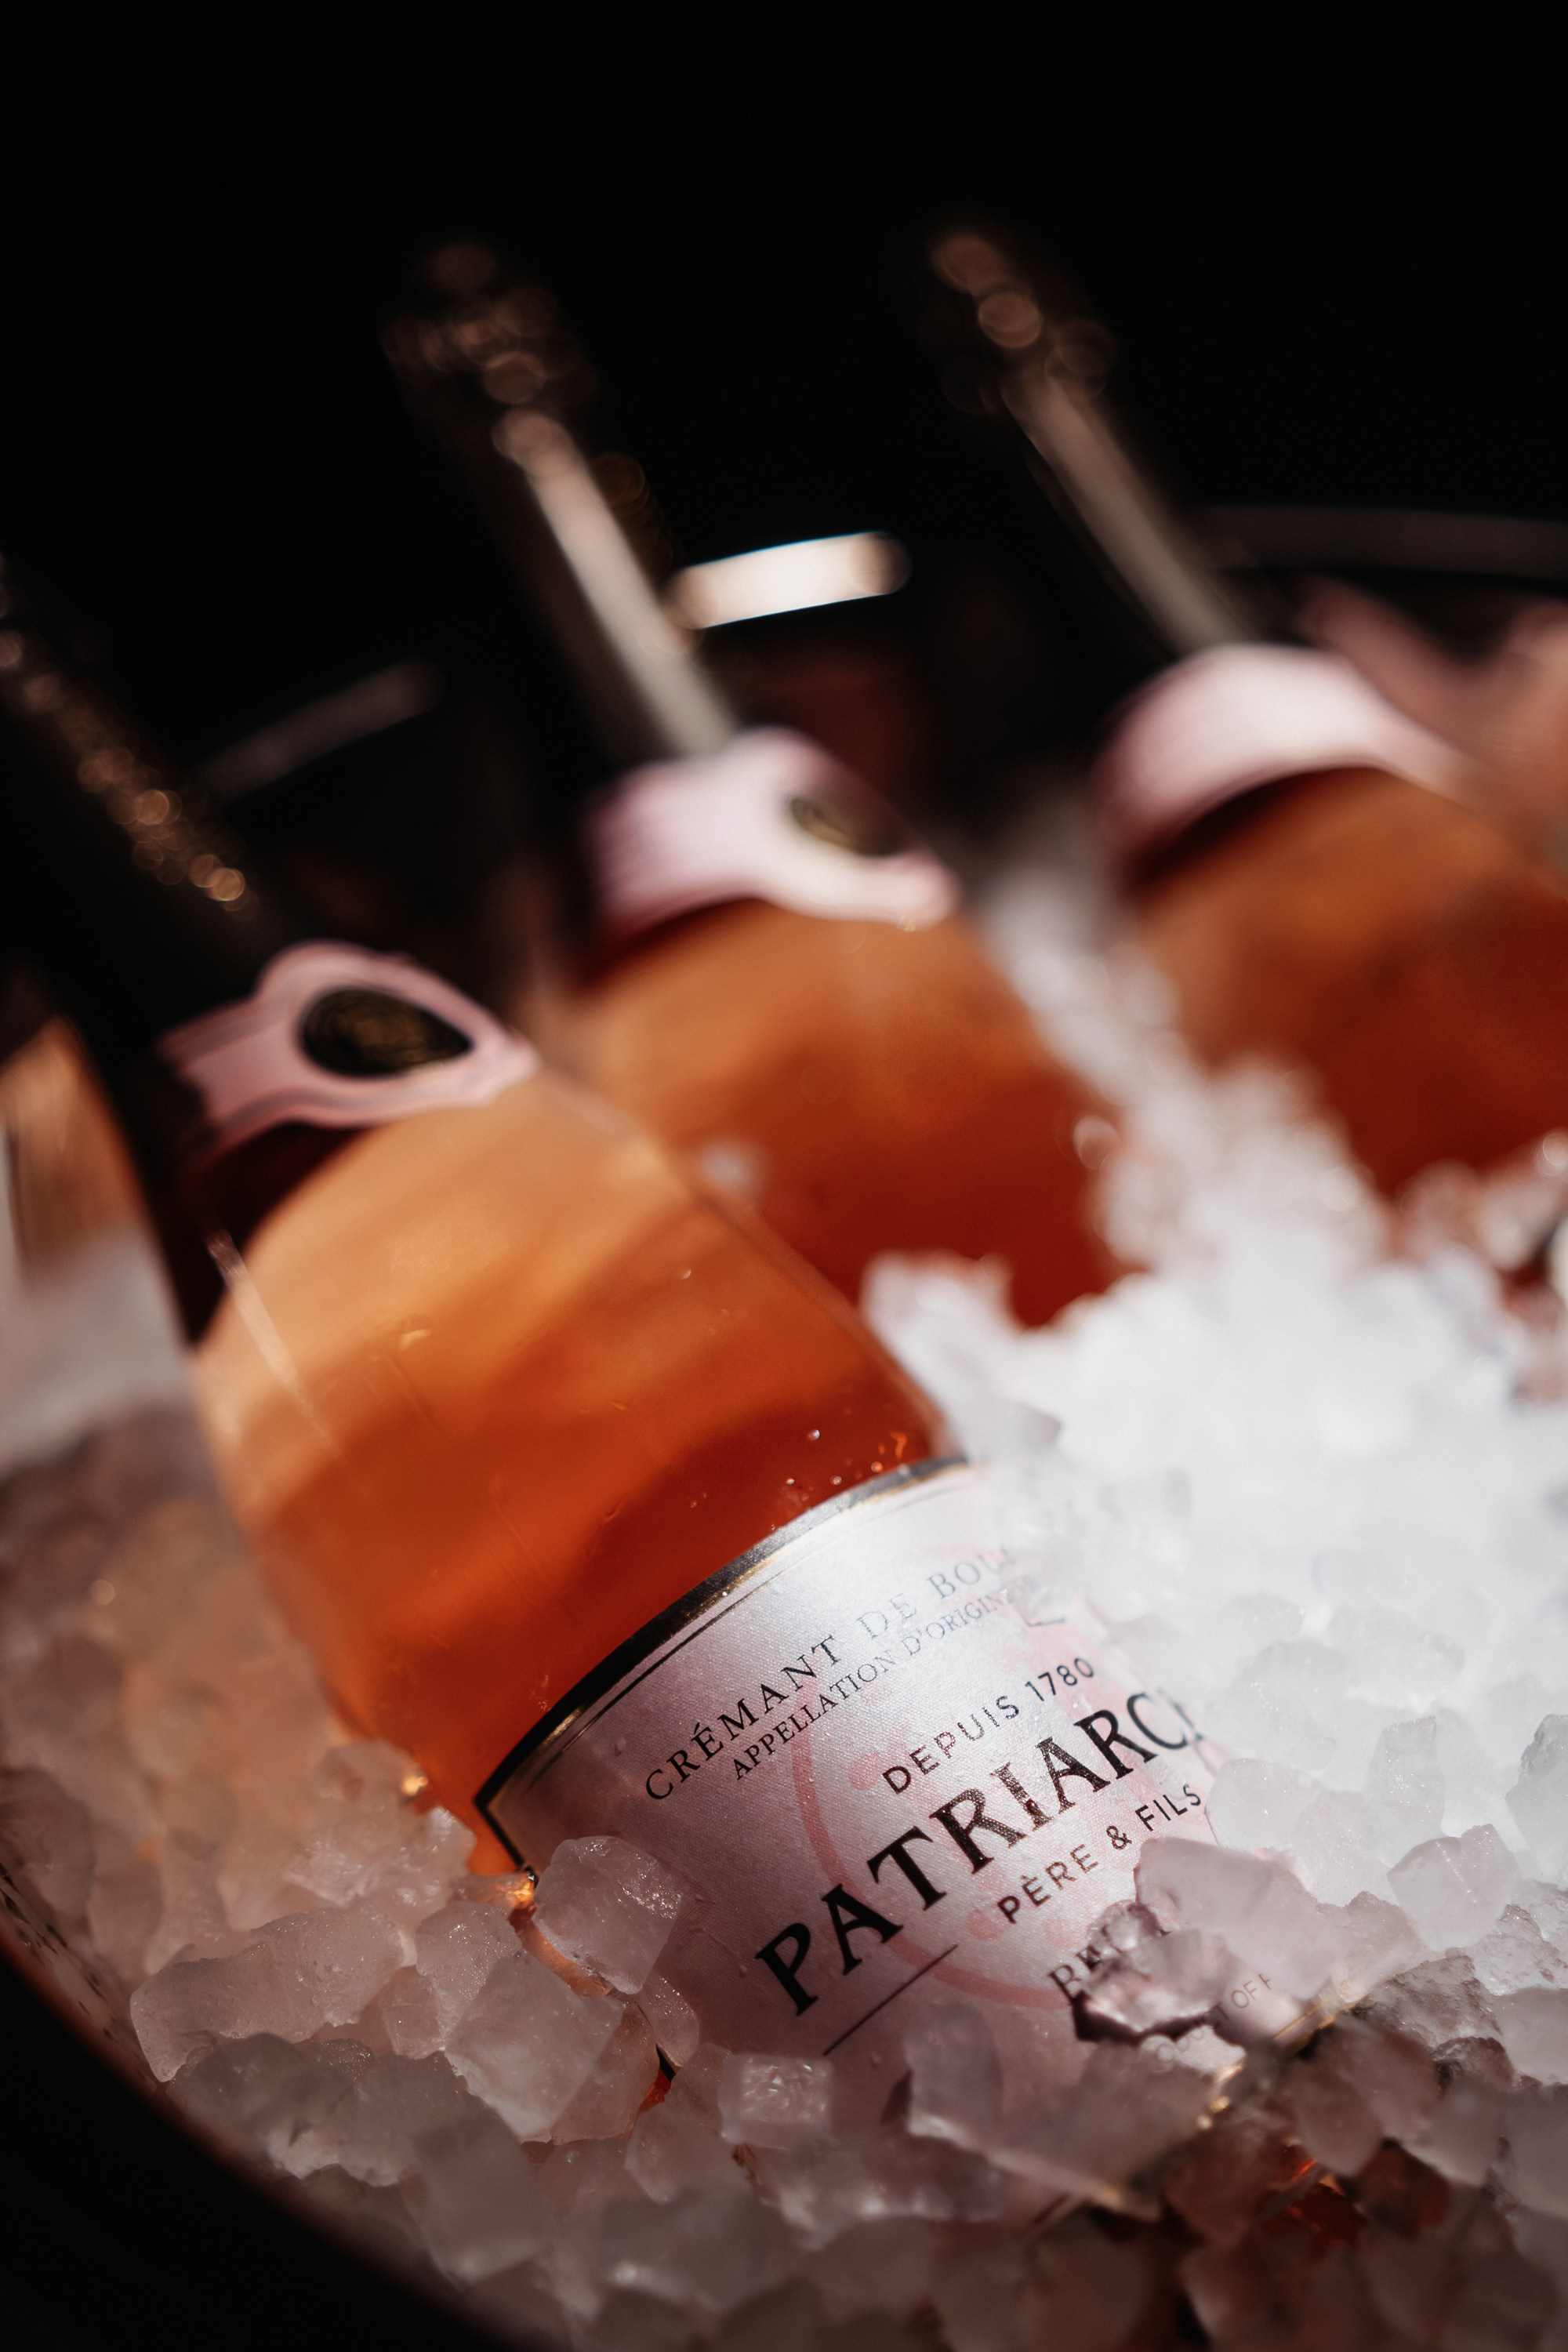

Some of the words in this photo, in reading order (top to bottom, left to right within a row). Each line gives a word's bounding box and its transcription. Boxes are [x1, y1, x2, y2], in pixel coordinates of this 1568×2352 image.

[644, 1634, 841, 1801] CRÉMANT
[855, 1593, 918, 1640] DE
[733, 1650, 897, 1780] APPELLATION
[882, 1695, 1020, 1795] DEPUIS
[1024, 1657, 1094, 1702] 1780
[997, 1843, 1099, 1925] PÈRE
[1105, 1824, 1134, 1851] &
[1134, 1782, 1203, 1832] FILS
